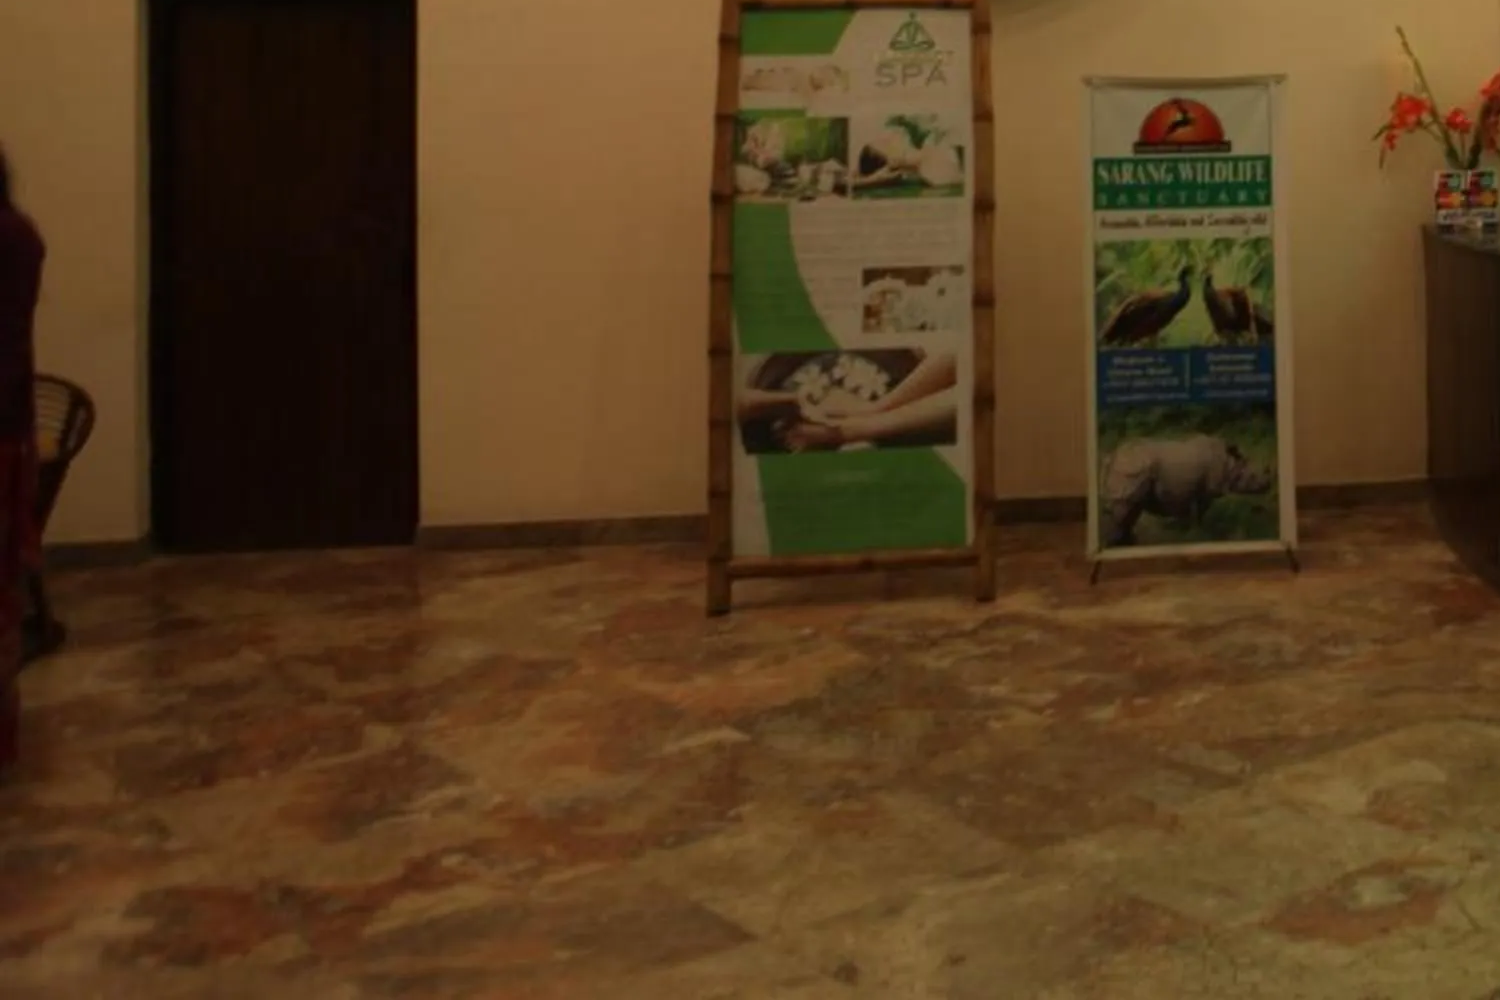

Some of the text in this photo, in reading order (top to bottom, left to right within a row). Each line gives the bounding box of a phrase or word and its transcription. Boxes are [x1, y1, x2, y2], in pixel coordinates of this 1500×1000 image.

[875, 60, 947, 87] SPA
[1097, 160, 1267, 185] SARANG WILDLIFE
[1098, 189, 1267, 206] SANCTUARY
